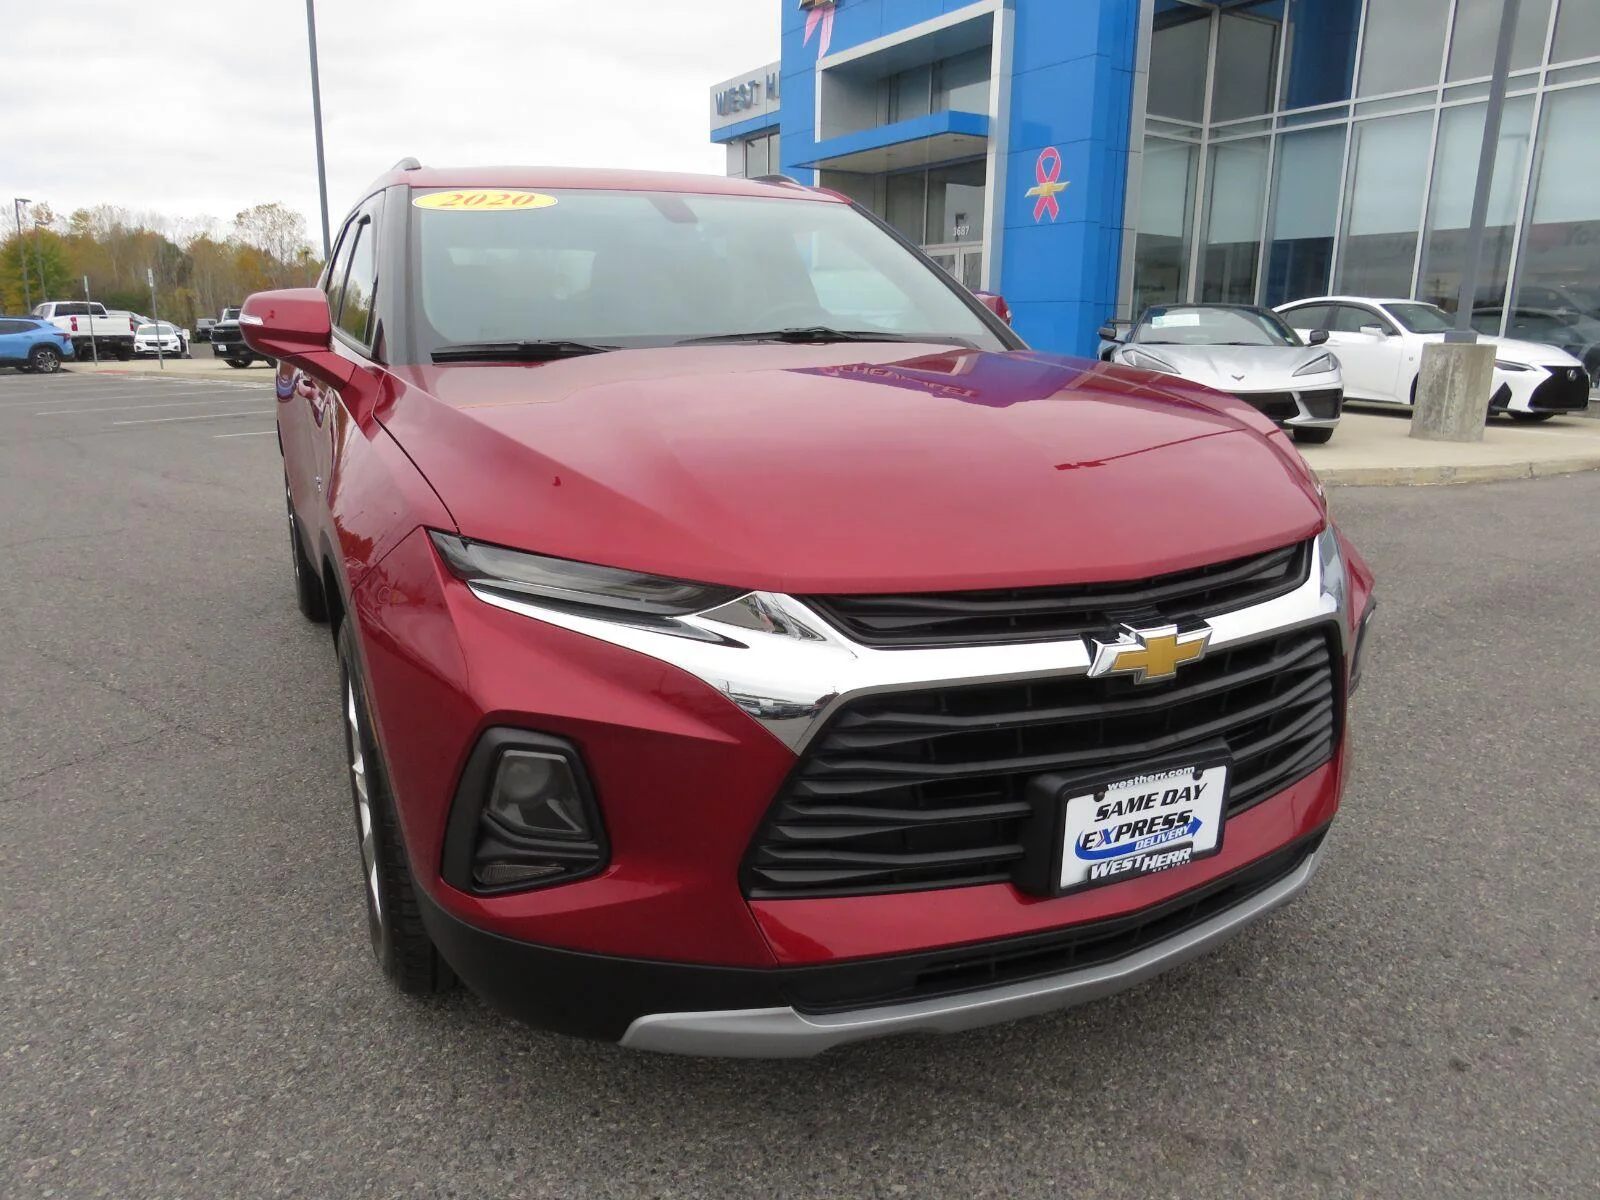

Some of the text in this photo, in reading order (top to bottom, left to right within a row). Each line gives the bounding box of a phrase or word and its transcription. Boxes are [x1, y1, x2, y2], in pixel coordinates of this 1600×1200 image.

[715, 79, 760, 116] WEST
[439, 194, 536, 207] 2020
[1107, 766, 1196, 791] westherr.com
[1094, 782, 1208, 822] SAME DAY
[1081, 810, 1193, 851] EXPRESS
[1135, 825, 1192, 851] DELIVERY
